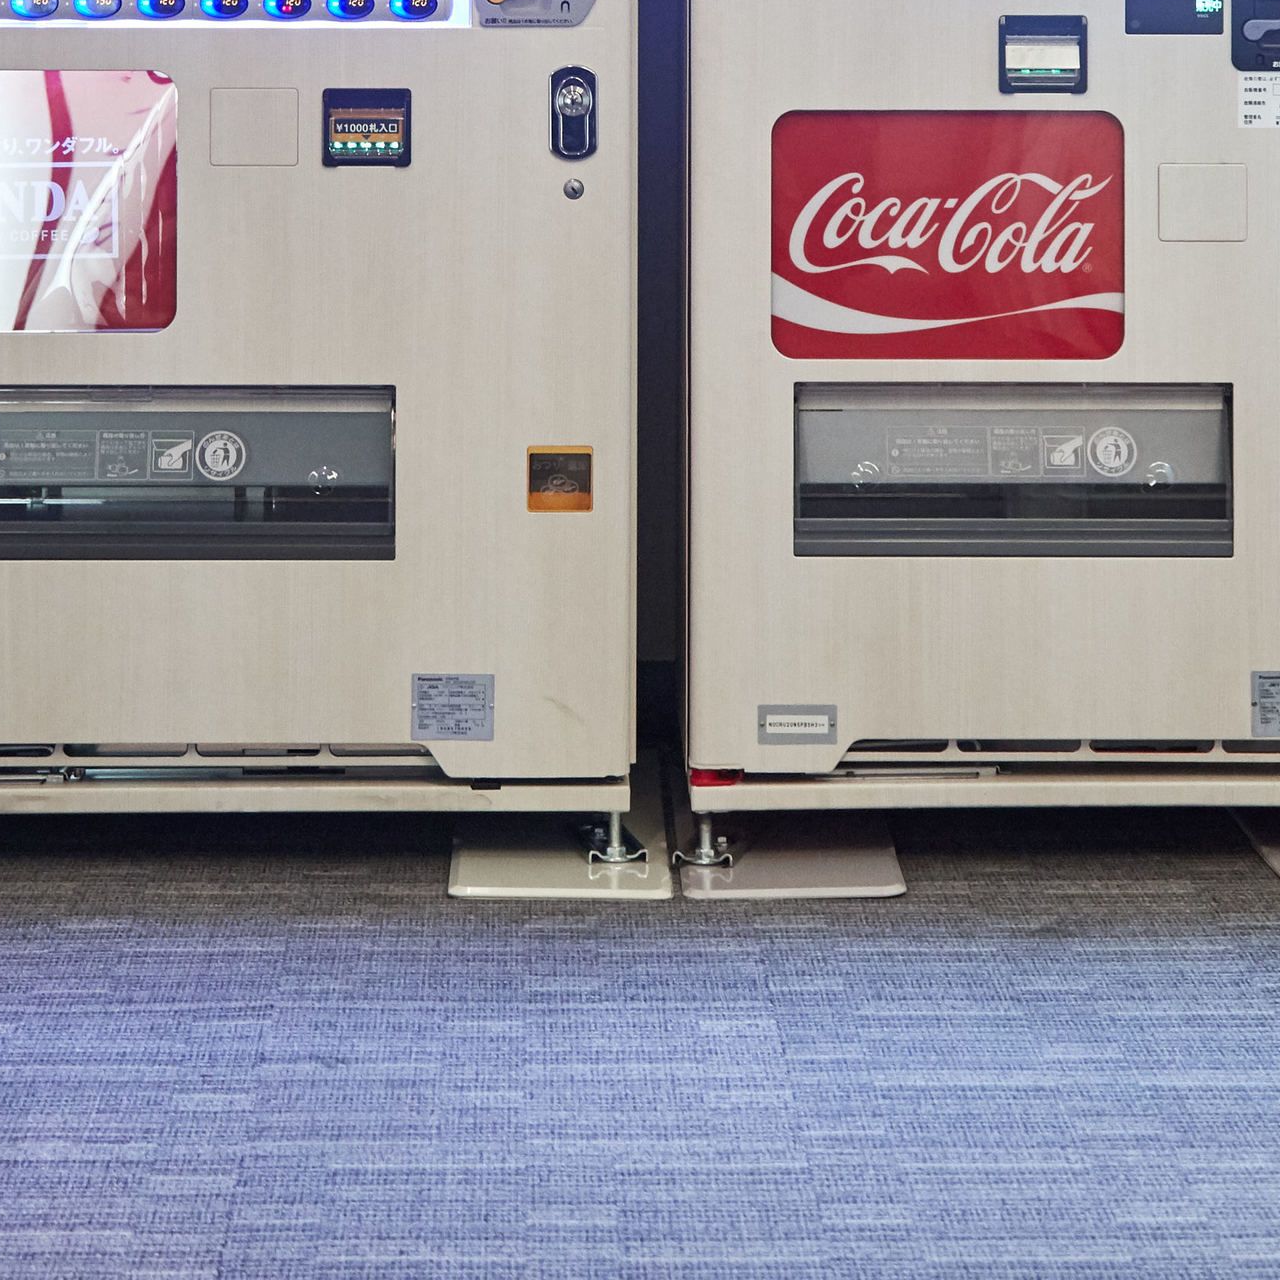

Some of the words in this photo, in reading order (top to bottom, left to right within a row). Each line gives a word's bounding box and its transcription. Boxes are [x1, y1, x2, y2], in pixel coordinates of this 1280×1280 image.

[336, 123, 398, 132] ¥1000札入口
[788, 171, 1114, 274] Coca-Cola
[9, 229, 70, 242] COFFEE
